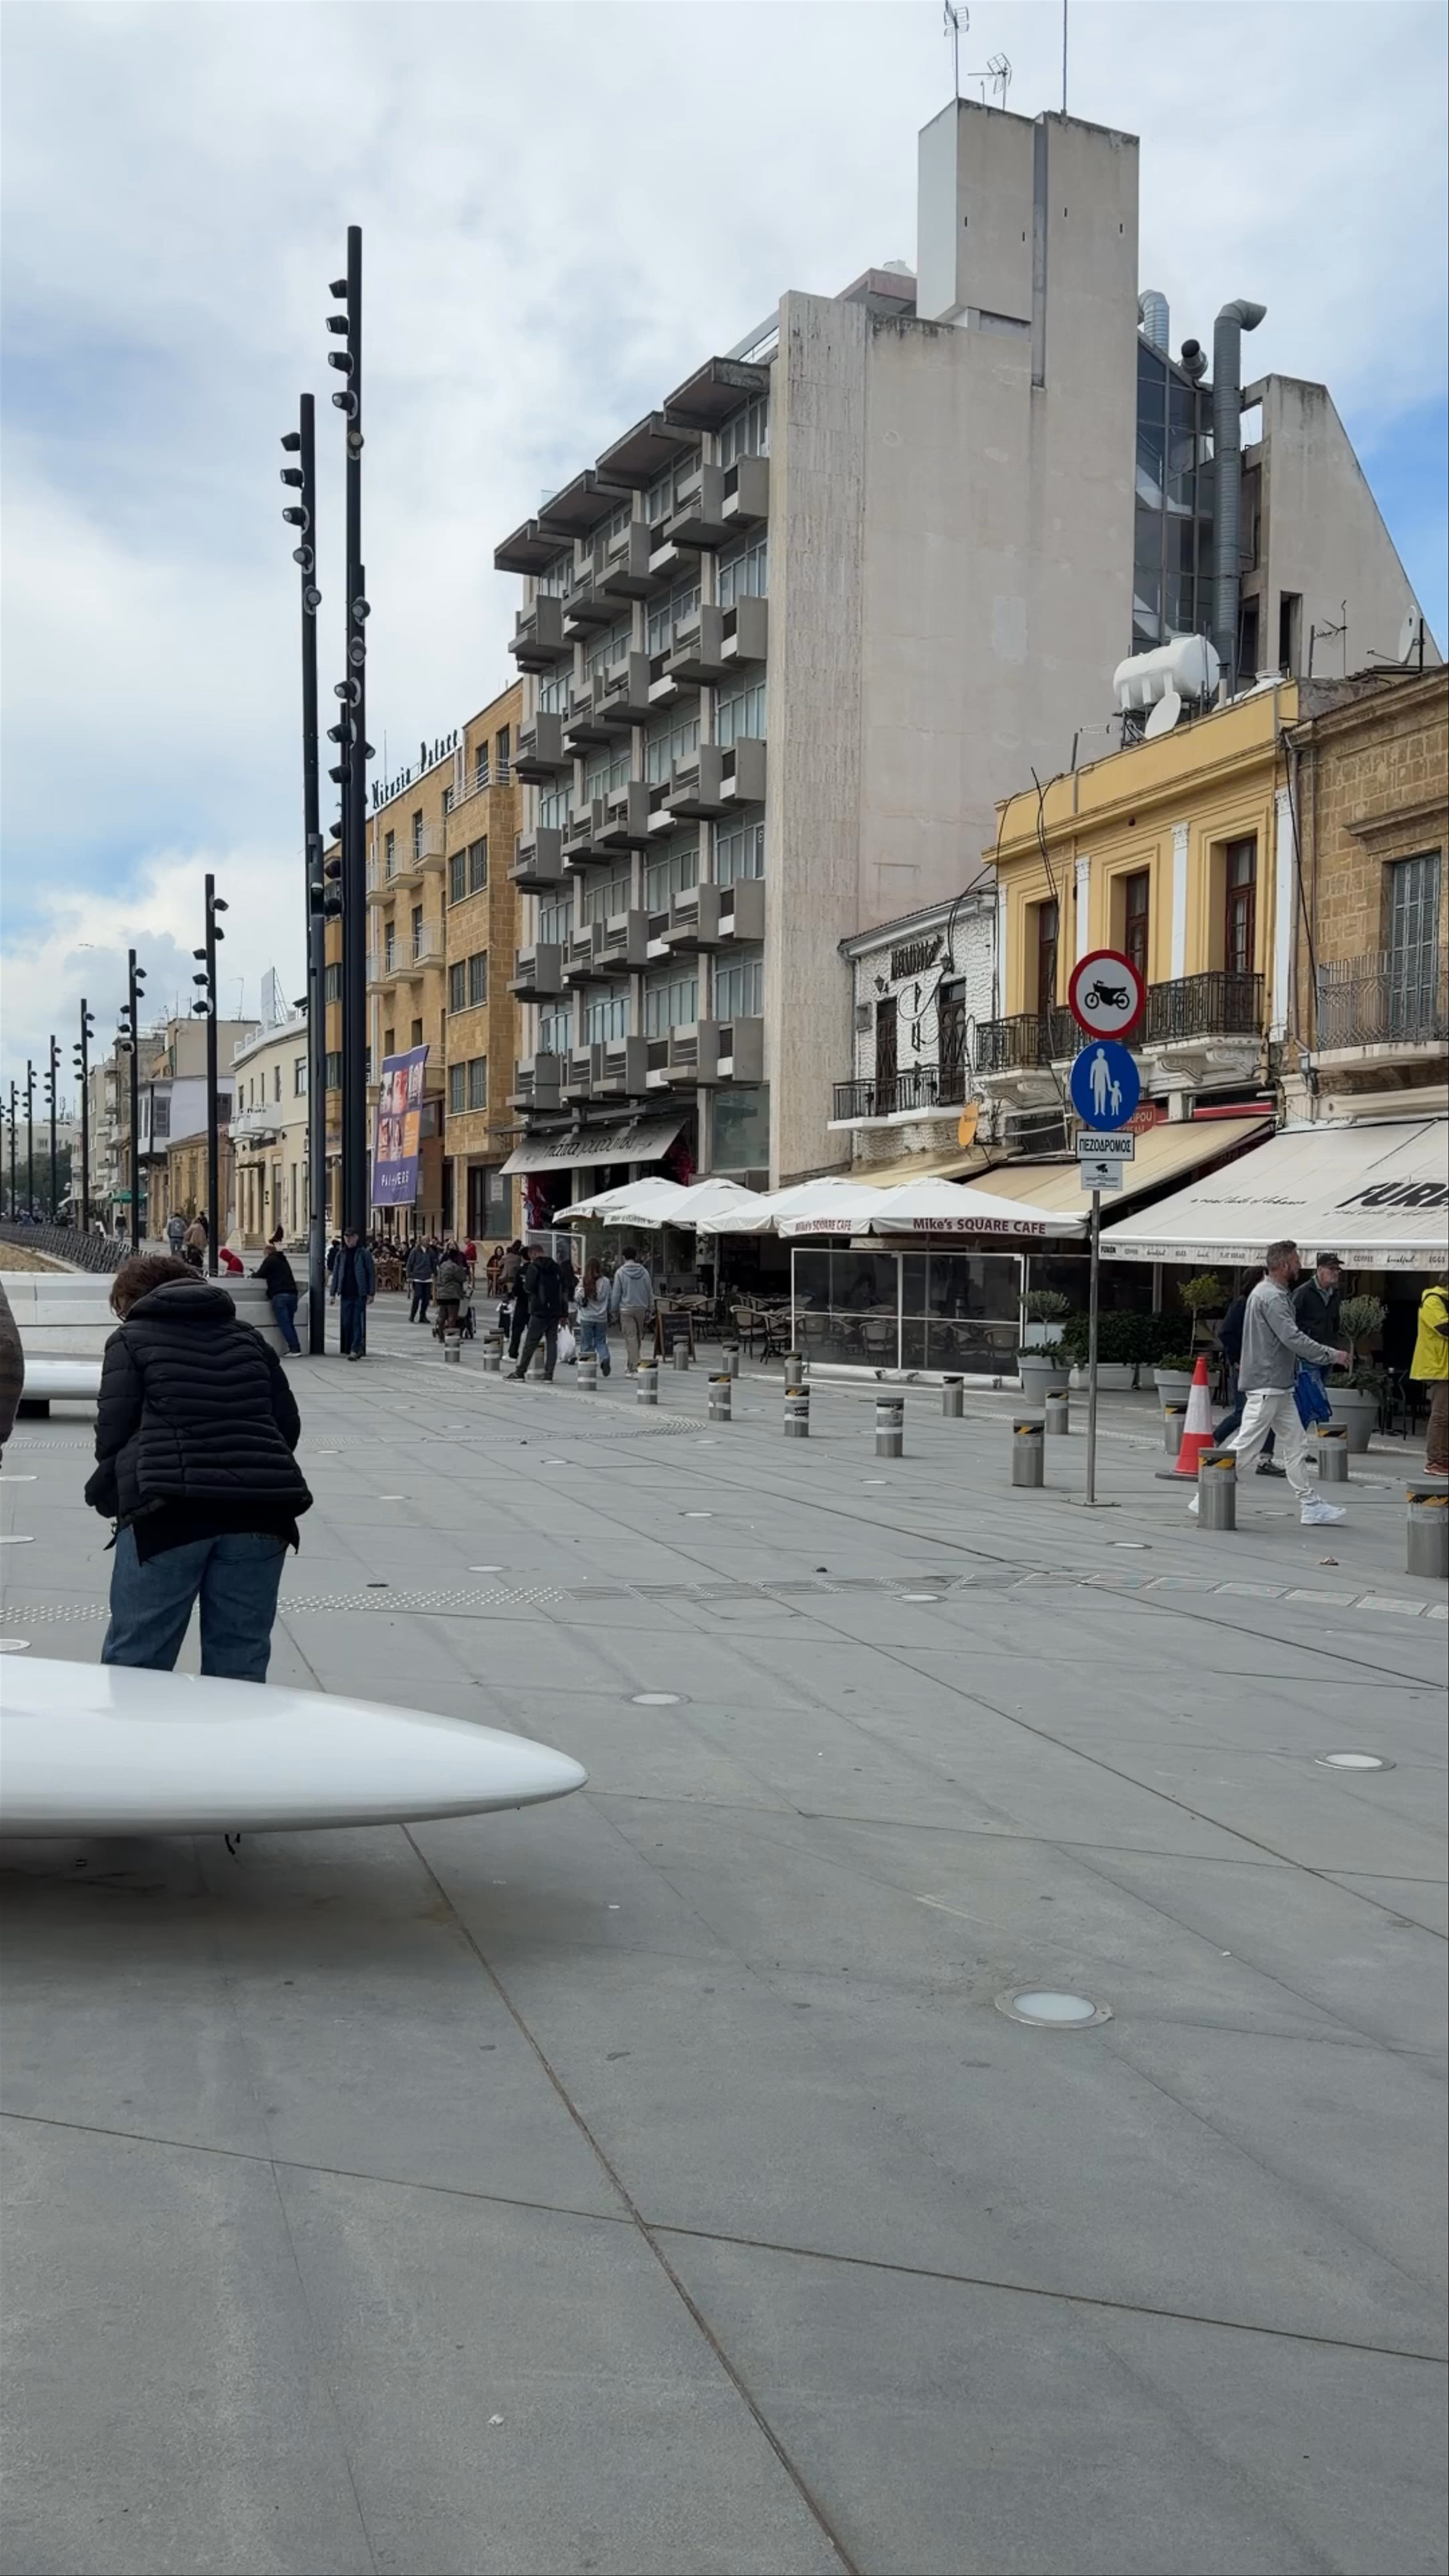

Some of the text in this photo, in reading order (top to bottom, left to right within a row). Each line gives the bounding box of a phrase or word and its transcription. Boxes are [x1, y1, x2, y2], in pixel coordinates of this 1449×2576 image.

[372, 729, 457, 810] Nicosia Palace
[1079, 1138, 1131, 1153] ΠΕΖΟΔΡΟΜΟΣ
[813, 1220, 835, 1231] SQUARE
[837, 1220, 852, 1230] CAFE
[913, 1218, 1046, 1234] Mike's SQUARE CAFE
